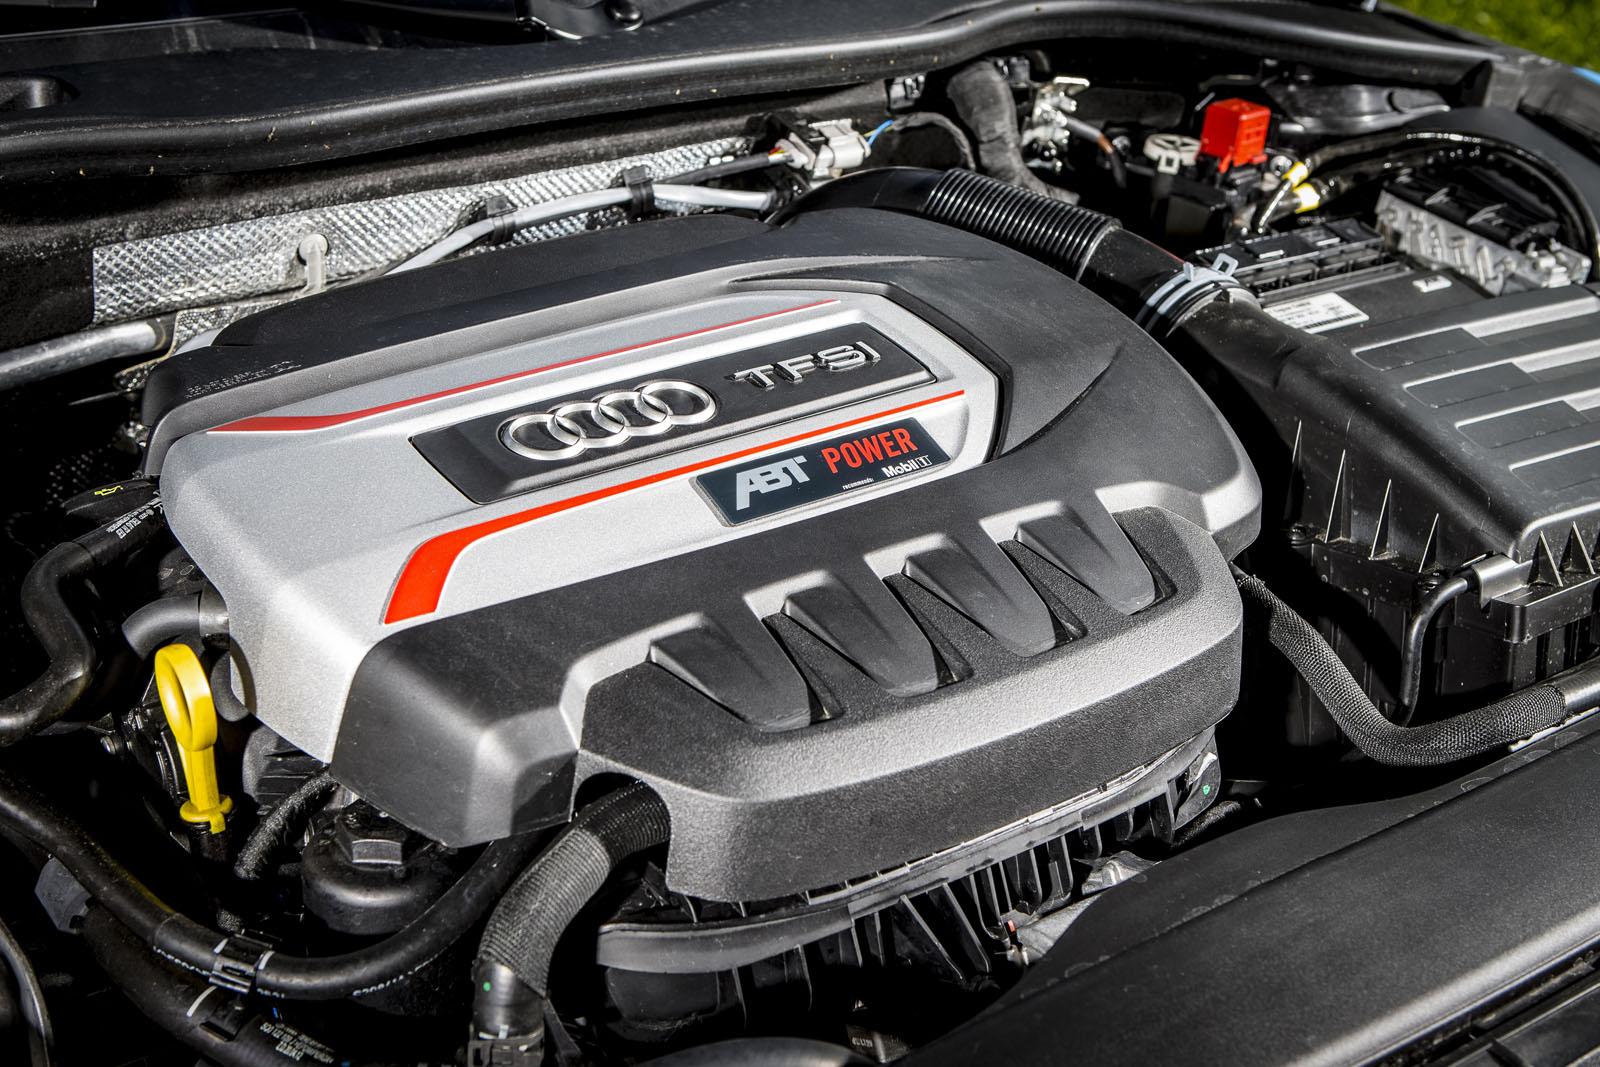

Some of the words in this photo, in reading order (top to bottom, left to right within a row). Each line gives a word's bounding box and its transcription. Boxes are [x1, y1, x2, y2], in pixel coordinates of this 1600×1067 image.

[730, 341, 881, 388] TFSI
[821, 428, 918, 474] POWER
[881, 459, 919, 478] Mobil
[736, 455, 810, 511] ABT
